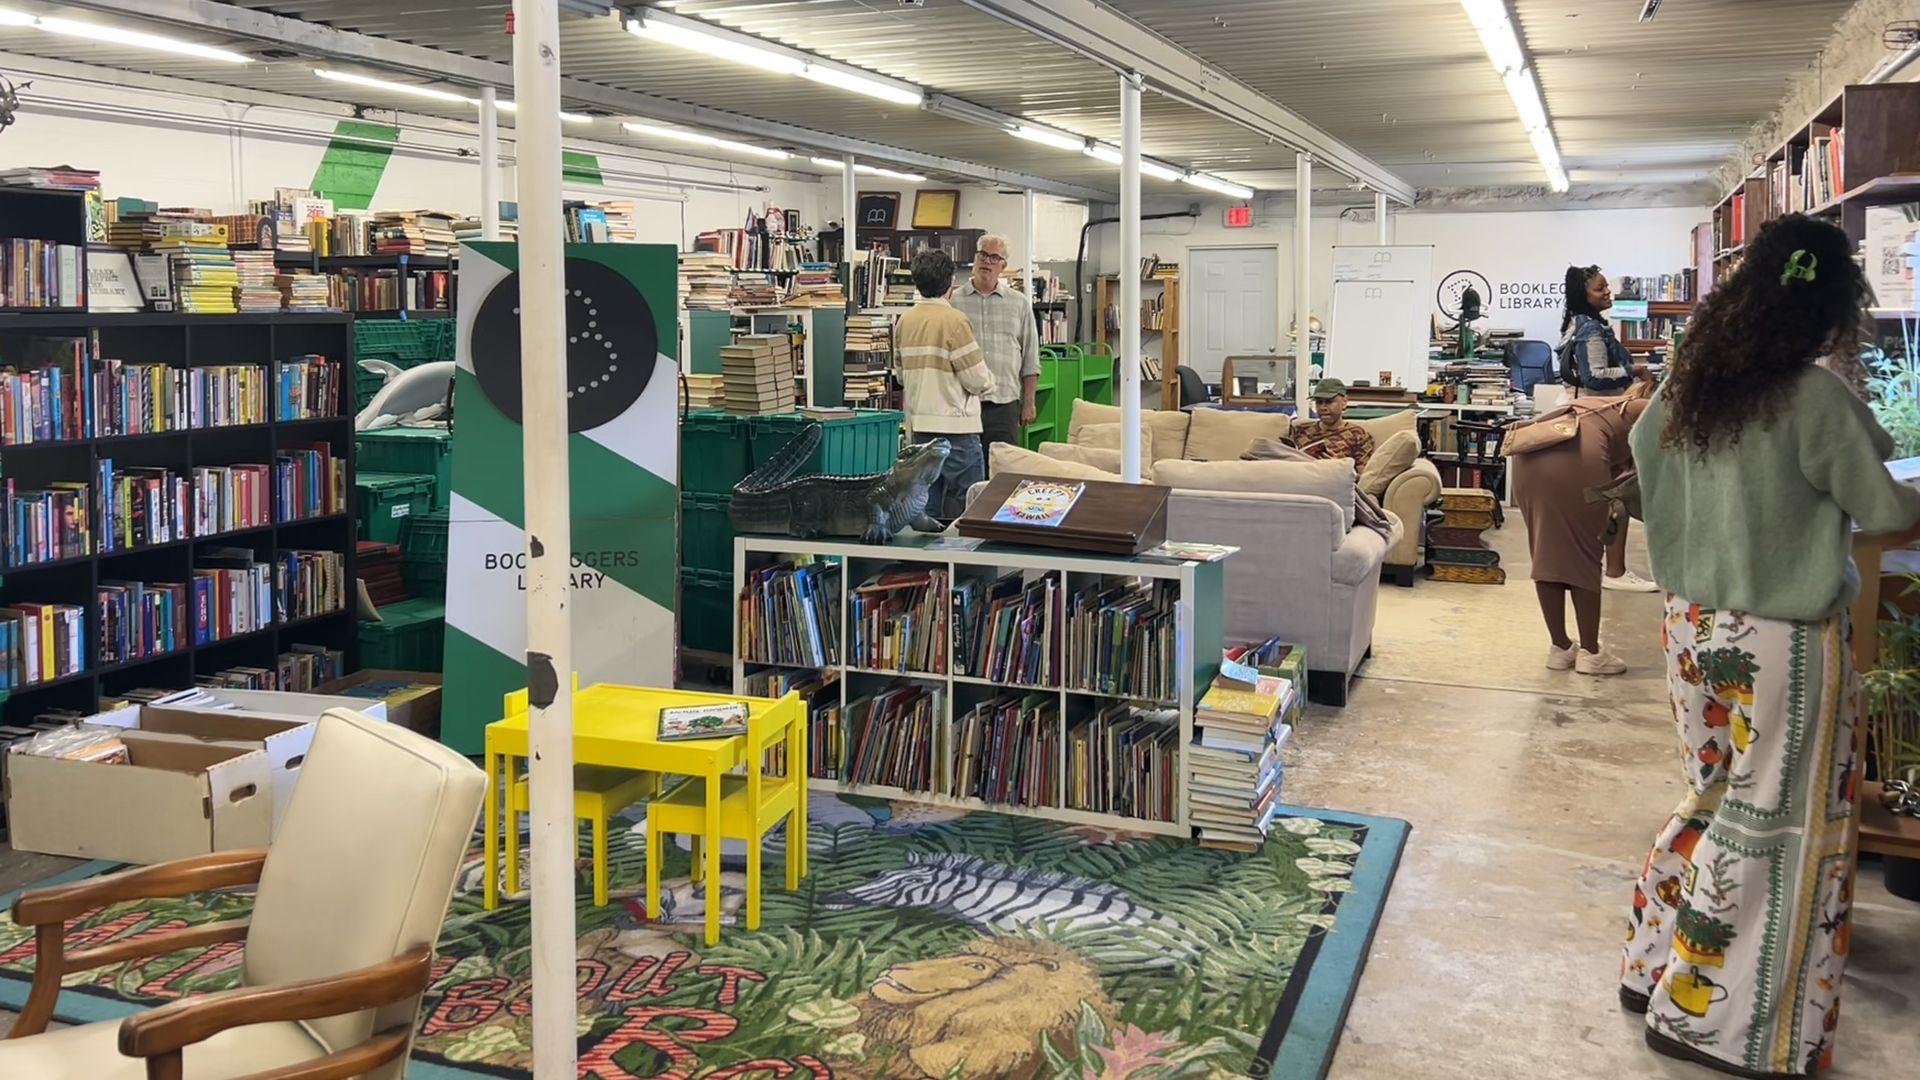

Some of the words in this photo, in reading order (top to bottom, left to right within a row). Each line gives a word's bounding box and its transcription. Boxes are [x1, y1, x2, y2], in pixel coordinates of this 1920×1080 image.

[1499, 297, 1562, 309] LIBRARY
[485, 550, 639, 570] BOOGGERS
[517, 572, 606, 590] LARY
